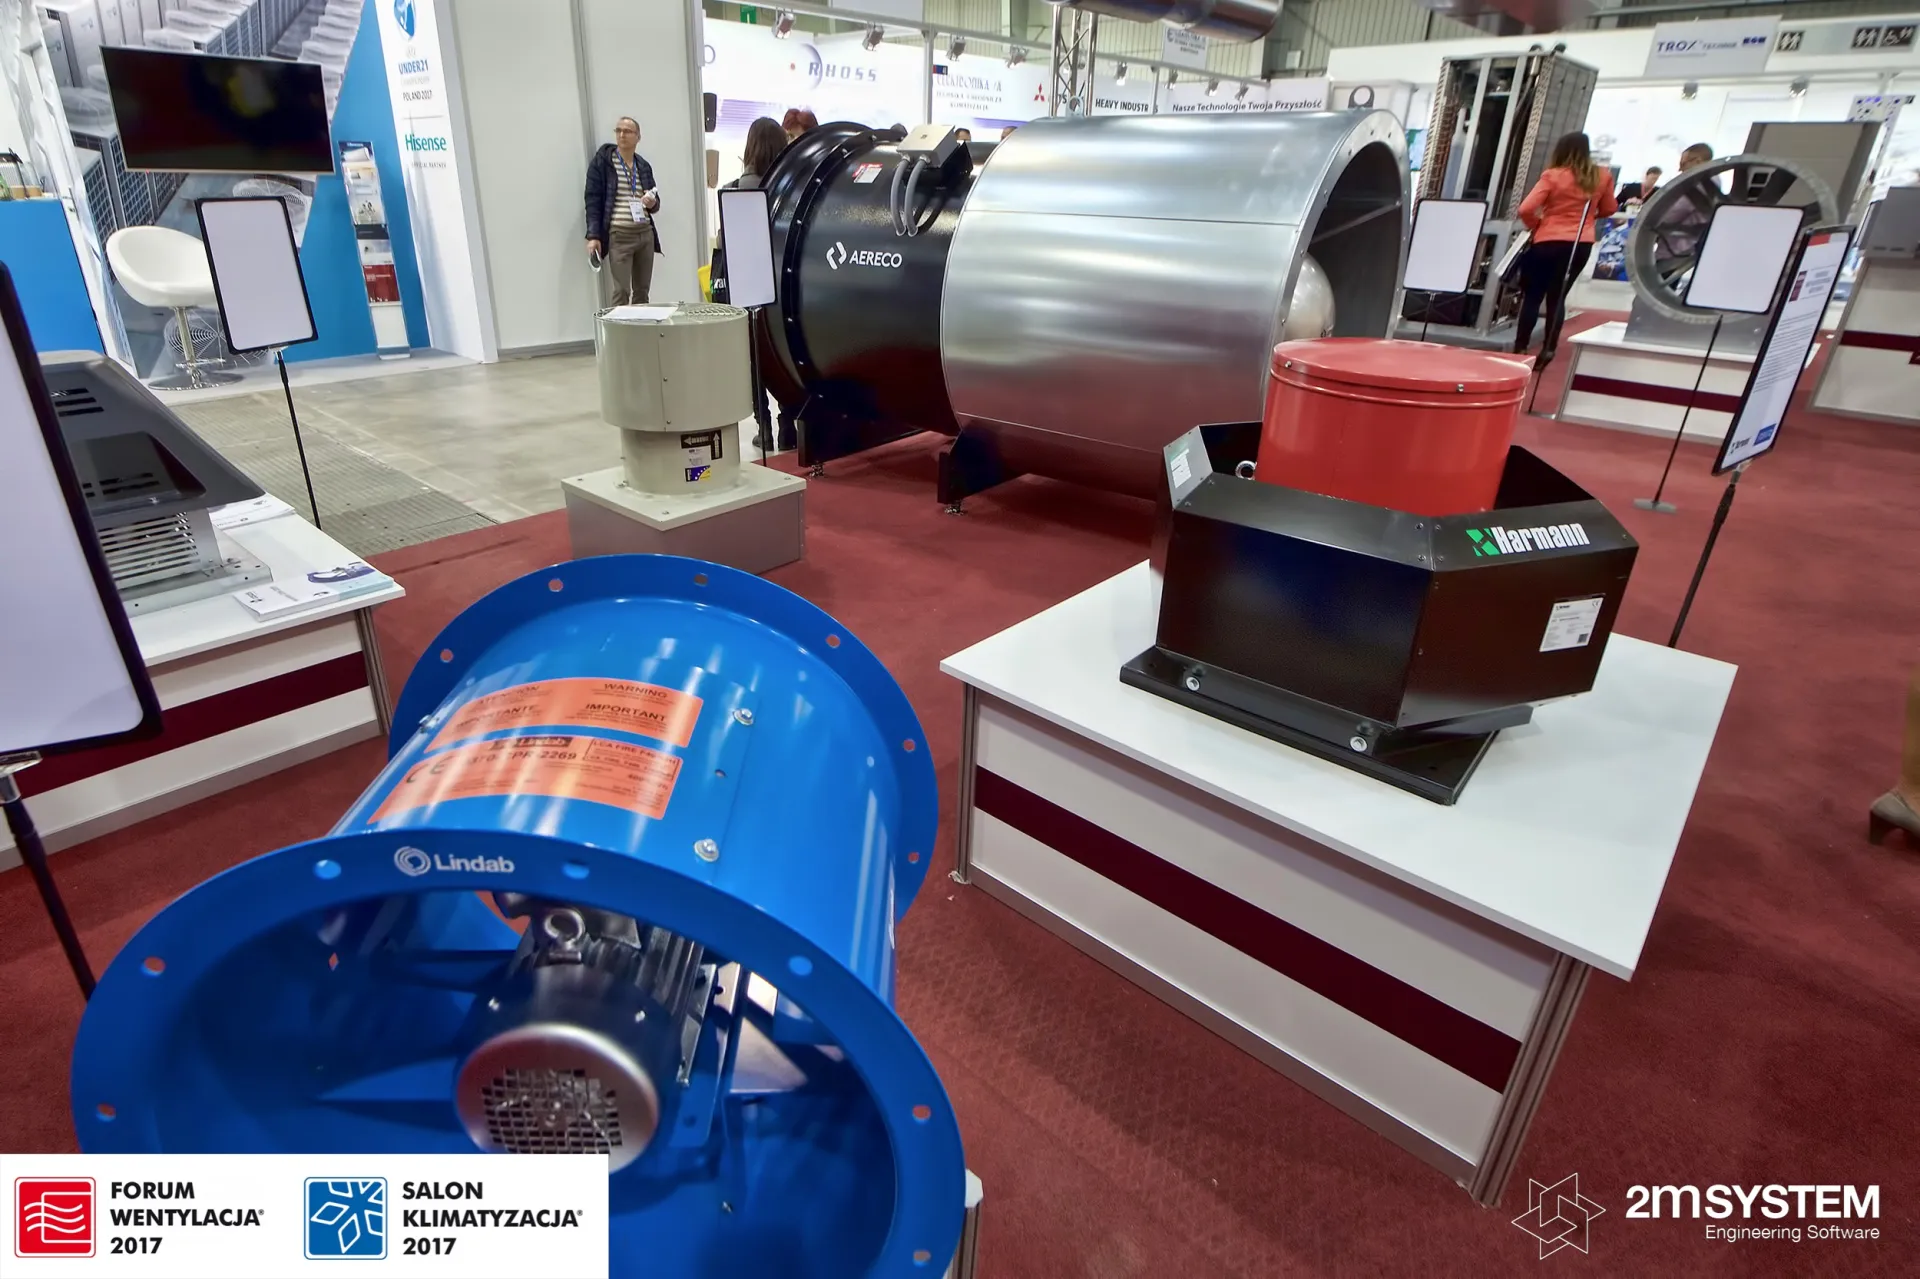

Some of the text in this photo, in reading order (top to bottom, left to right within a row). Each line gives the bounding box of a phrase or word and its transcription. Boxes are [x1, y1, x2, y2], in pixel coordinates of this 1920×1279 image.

[398, 59, 429, 75] UNDER21
[808, 61, 878, 82] RHOSS
[1095, 98, 1118, 110] HEAVY
[1172, 100, 1322, 113] Nasze Technologie Twoja Przyszłość
[404, 133, 447, 152] Hisense
[849, 249, 903, 268] AERECO
[1491, 523, 1591, 555] Harmann
[604, 683, 668, 699] WARNING
[585, 703, 666, 722] IMPORTANT
[434, 854, 515, 874] Lindab
